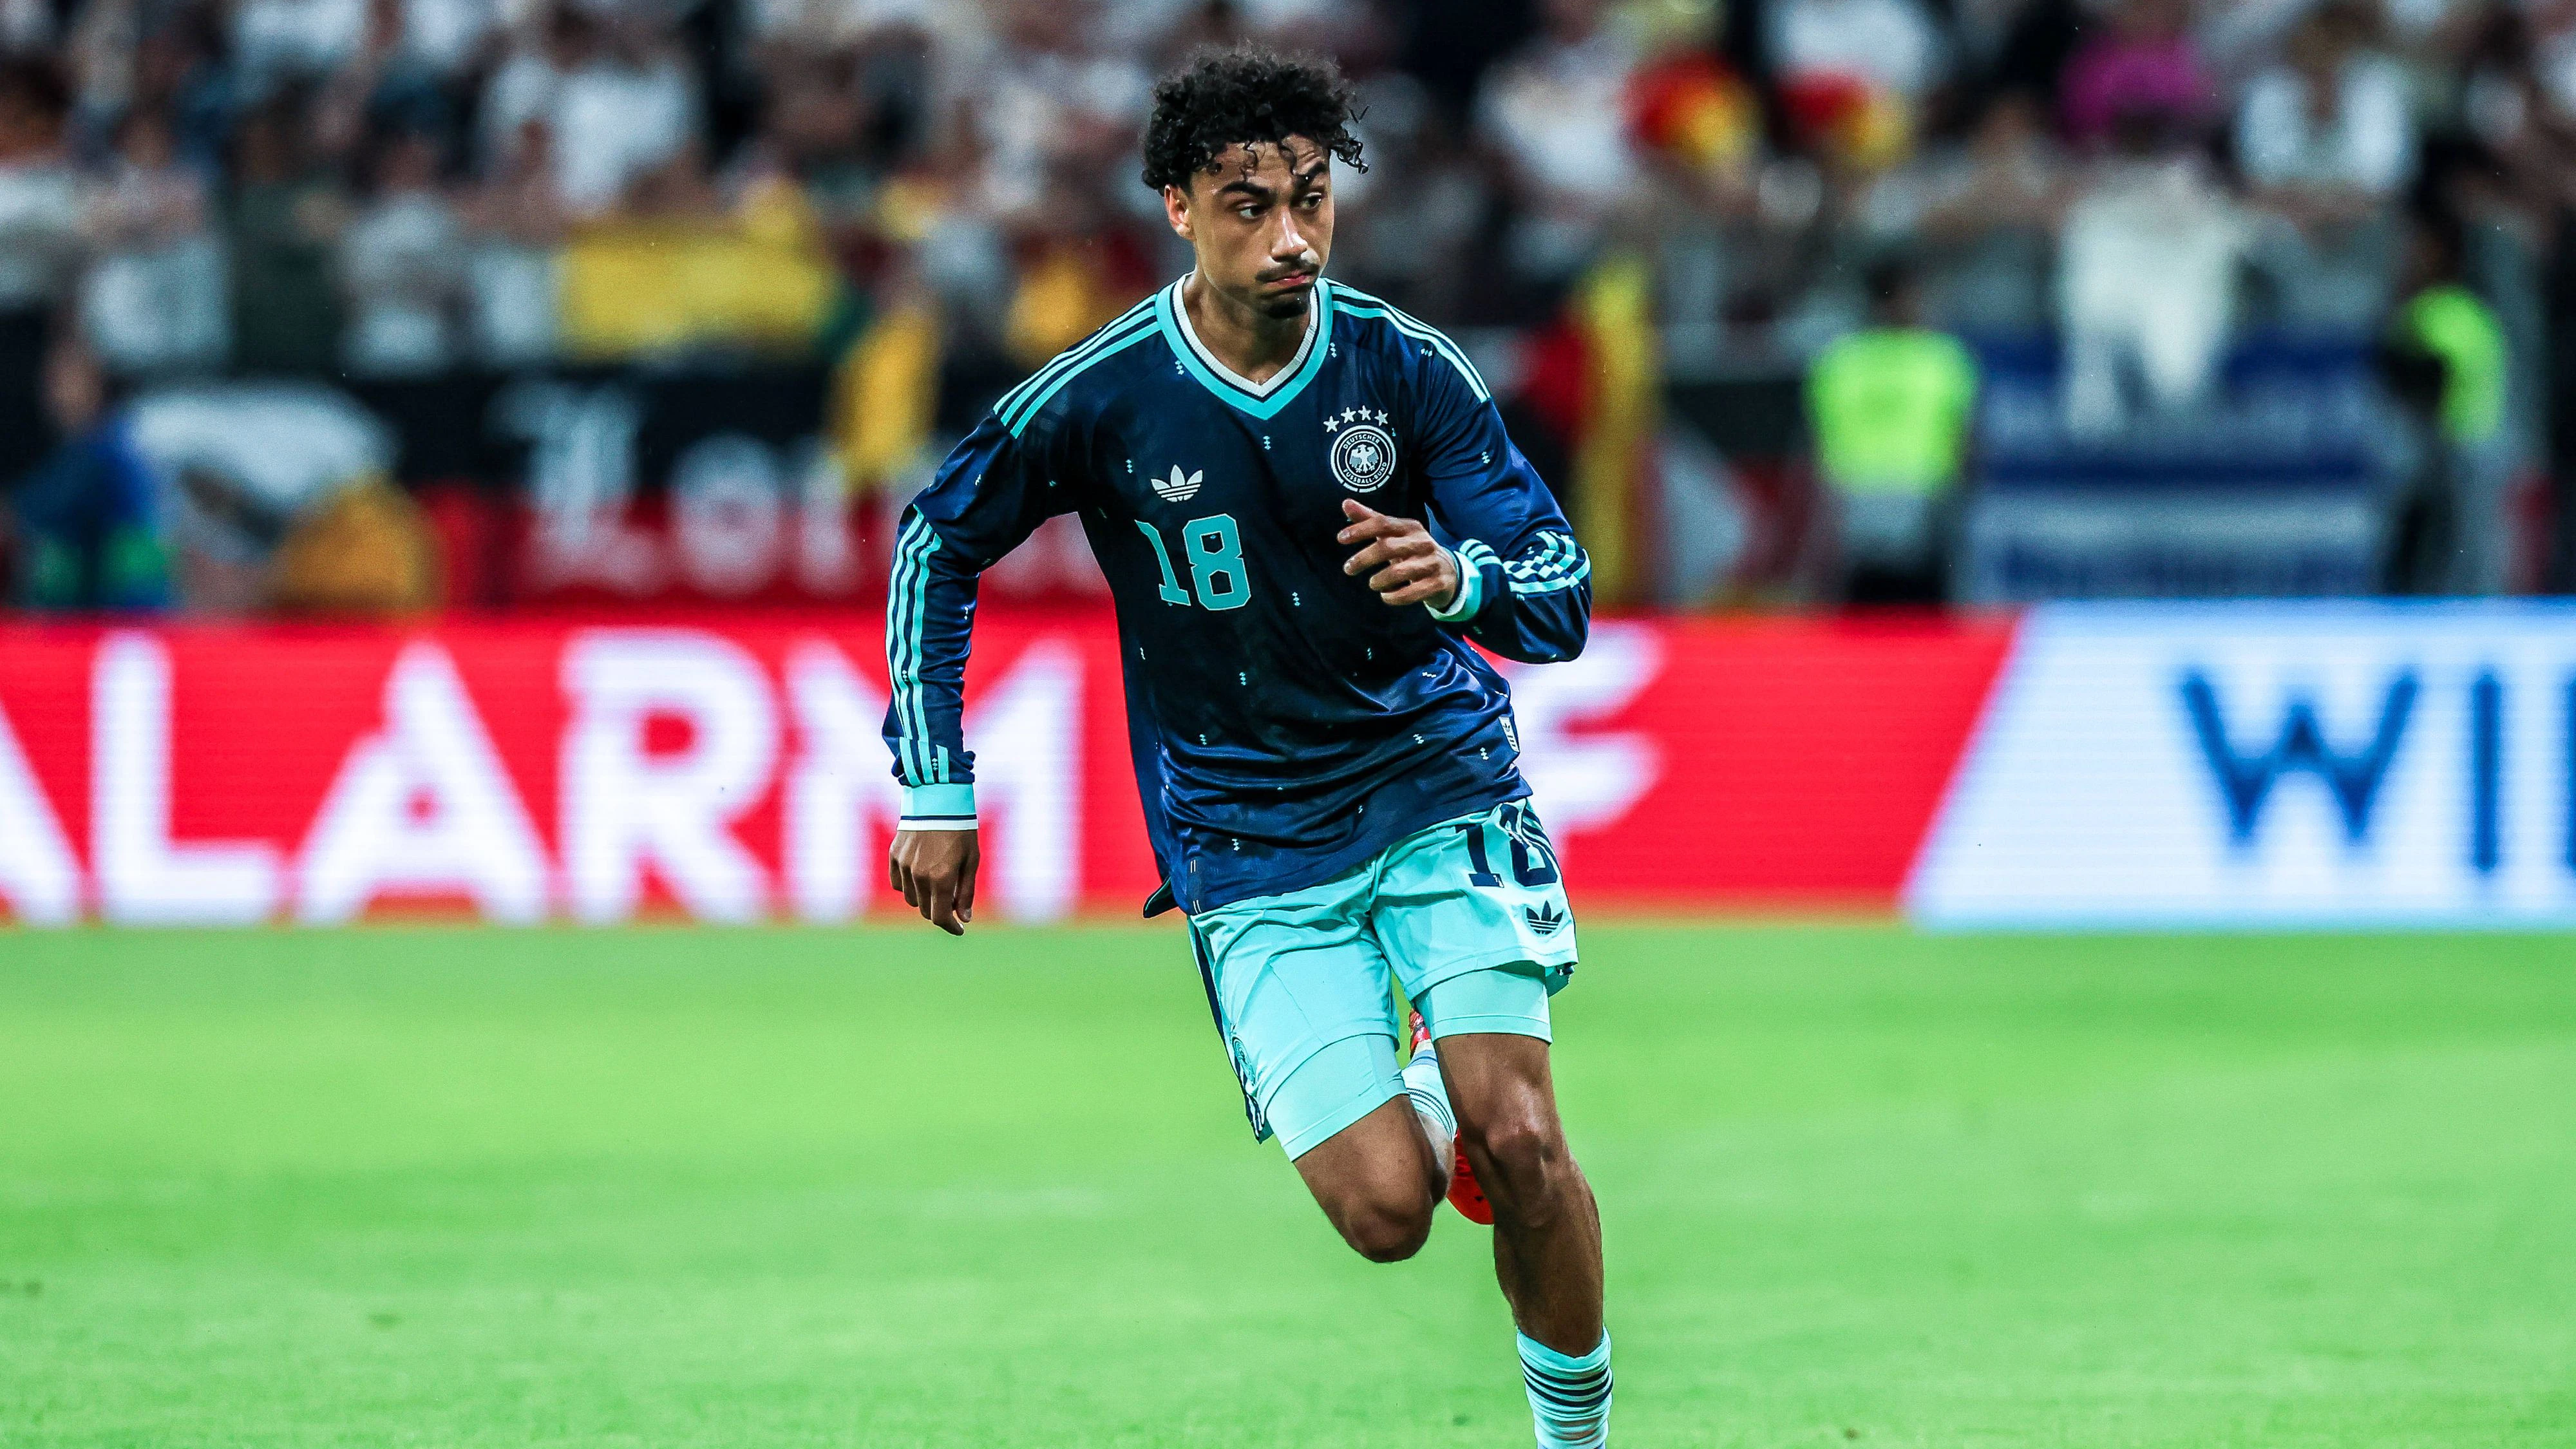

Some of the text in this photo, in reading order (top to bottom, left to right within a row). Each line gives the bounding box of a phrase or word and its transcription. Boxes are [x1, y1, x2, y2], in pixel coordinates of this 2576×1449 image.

[1343, 433, 1380, 450] DEUTSCHER
[1343, 462, 1387, 484] FUSSBALL-BUND
[1134, 513, 1251, 611] 18
[2182, 667, 2576, 875] WI
